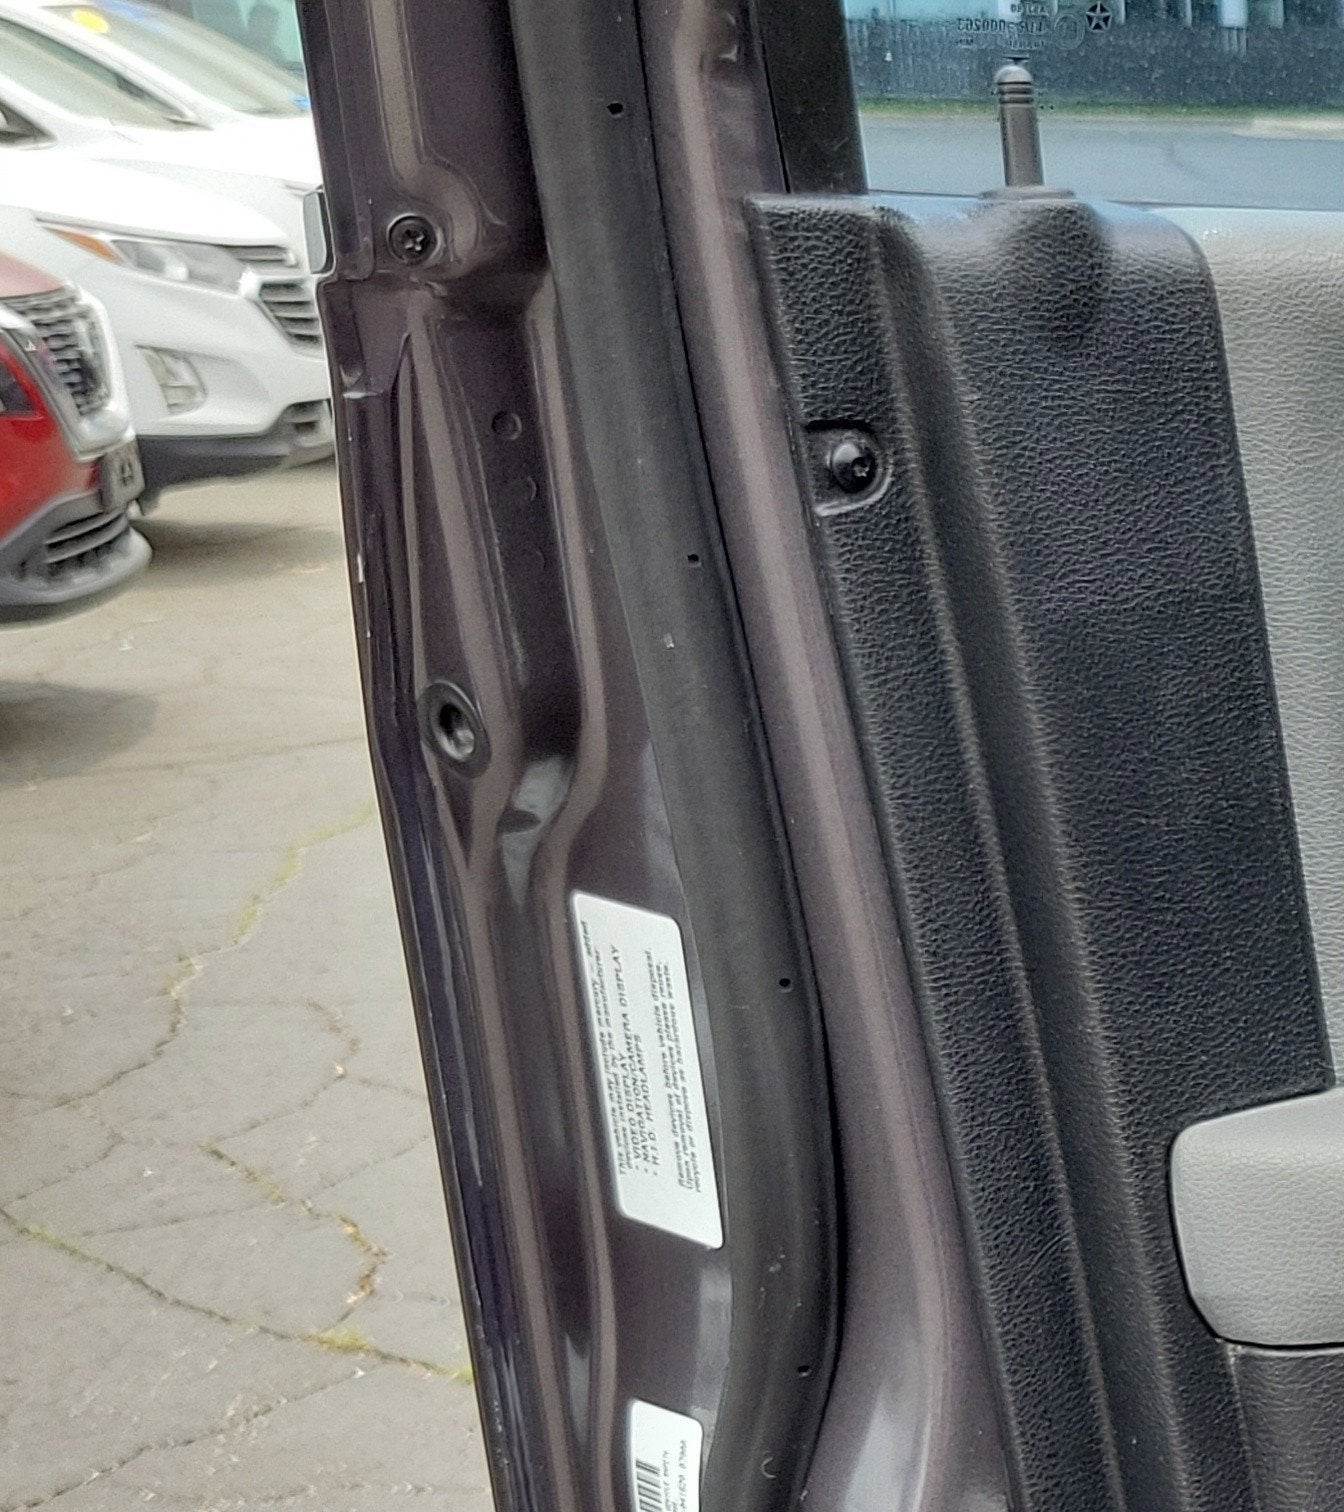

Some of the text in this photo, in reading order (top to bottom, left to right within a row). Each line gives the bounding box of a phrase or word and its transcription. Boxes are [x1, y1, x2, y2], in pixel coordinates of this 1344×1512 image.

[610, 944, 650, 1163] NAVIGATION/CAMERA DISPLAY
[617, 1051, 642, 1161] VIDEO DISPLAY
[633, 1033, 653, 1122] HEADLAMPS
